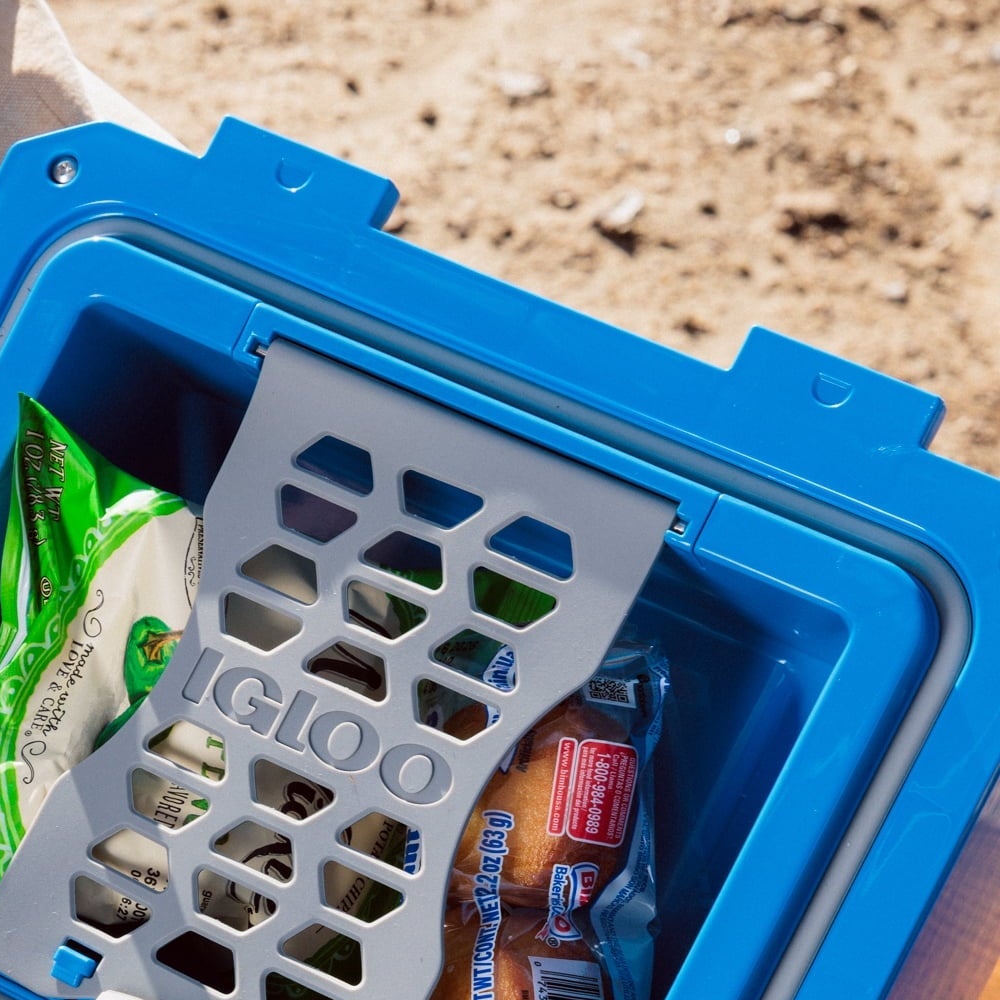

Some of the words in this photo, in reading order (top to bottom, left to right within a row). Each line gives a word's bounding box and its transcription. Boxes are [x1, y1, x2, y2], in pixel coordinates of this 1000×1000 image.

[49, 439, 68, 482] NET
[44, 486, 64, 522] WT
[67, 643, 95, 688] made
[47, 681, 63, 692] &
[42, 690, 69, 737] with
[182, 647, 453, 805] IGLOO
[611, 754, 620, 767] Call
[623, 757, 636, 793] QUESTIONS
[551, 742, 571, 831] www.bimbousa.com
[585, 753, 611, 834] 1-800-984-0989
[622, 794, 631, 803] OR
[484, 811, 513, 829] g)
[479, 829, 507, 854] (63
[482, 856, 501, 873] oz
[474, 875, 498, 897] 2.2
[477, 894, 500, 923] NET
